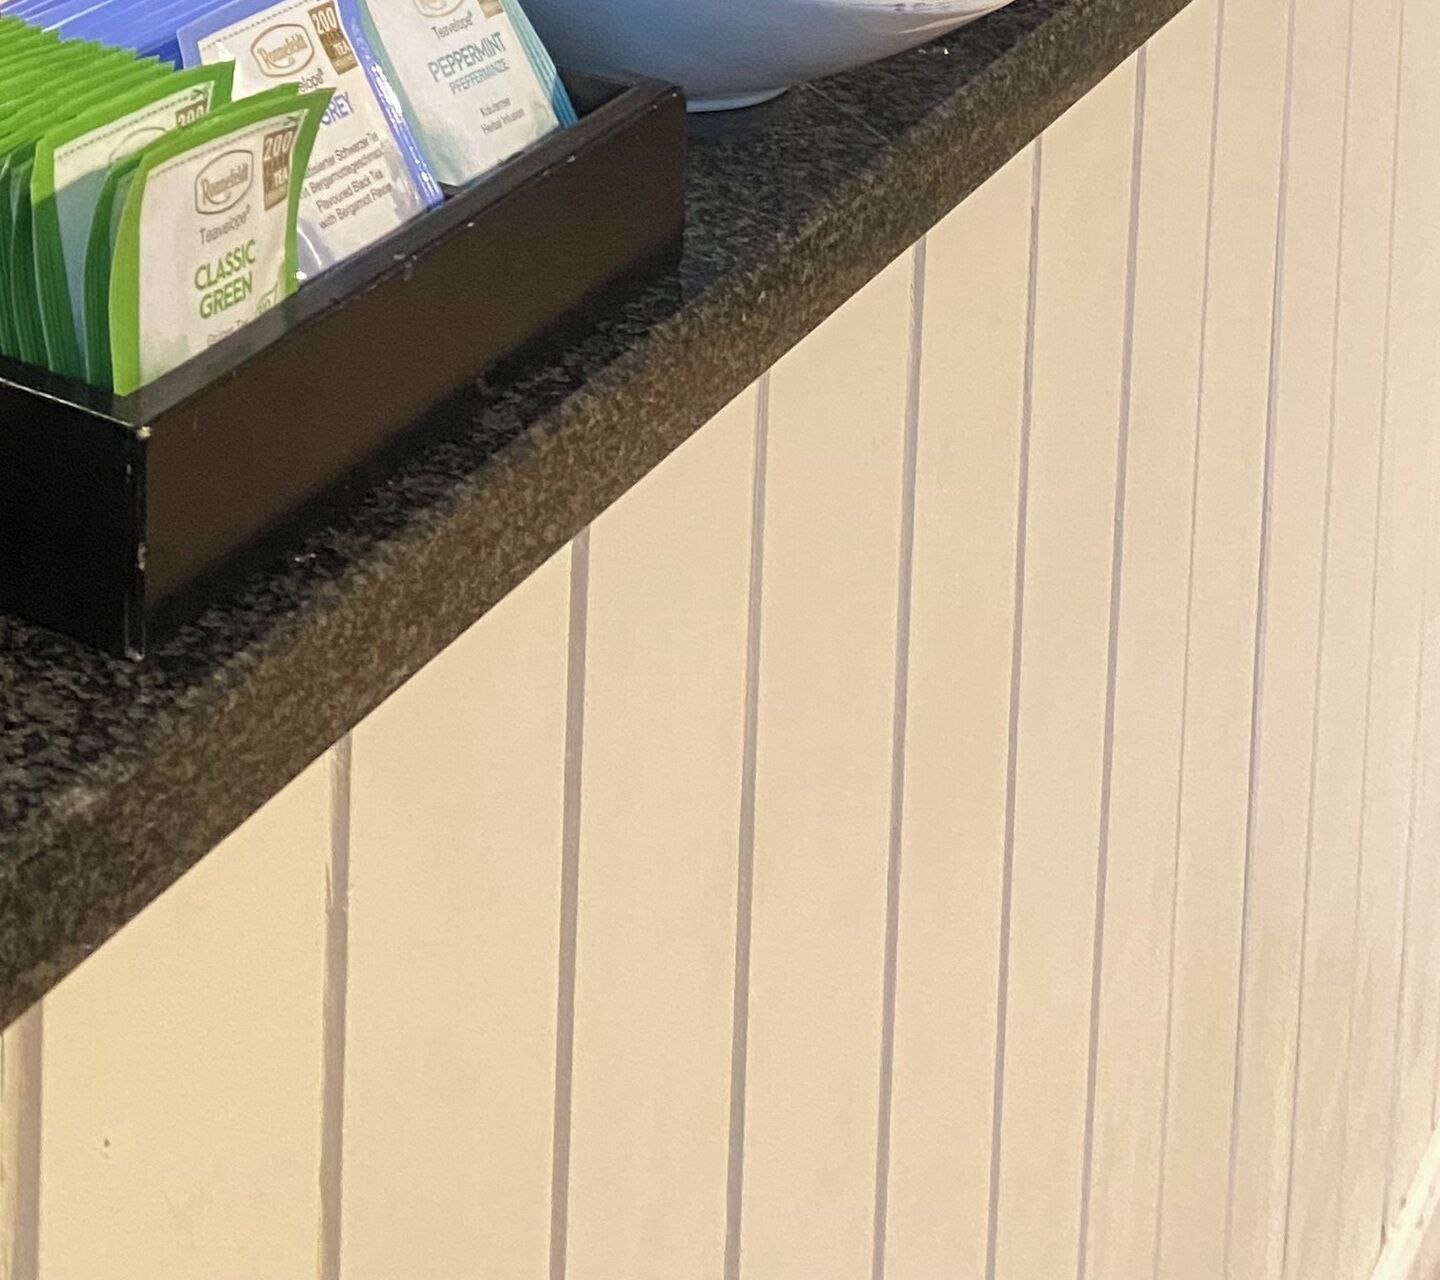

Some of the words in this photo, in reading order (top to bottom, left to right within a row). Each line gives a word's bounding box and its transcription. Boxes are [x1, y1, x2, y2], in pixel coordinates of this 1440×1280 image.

[311, 6, 338, 35] 200
[334, 40, 350, 56] TEA
[426, 30, 507, 83] PEPPERMINT
[448, 57, 511, 96] PFEFFERMINZE
[264, 130, 294, 160] 200
[318, 210, 338, 230] with
[193, 239, 256, 291] CLASSIC
[199, 270, 253, 320] GREEN
